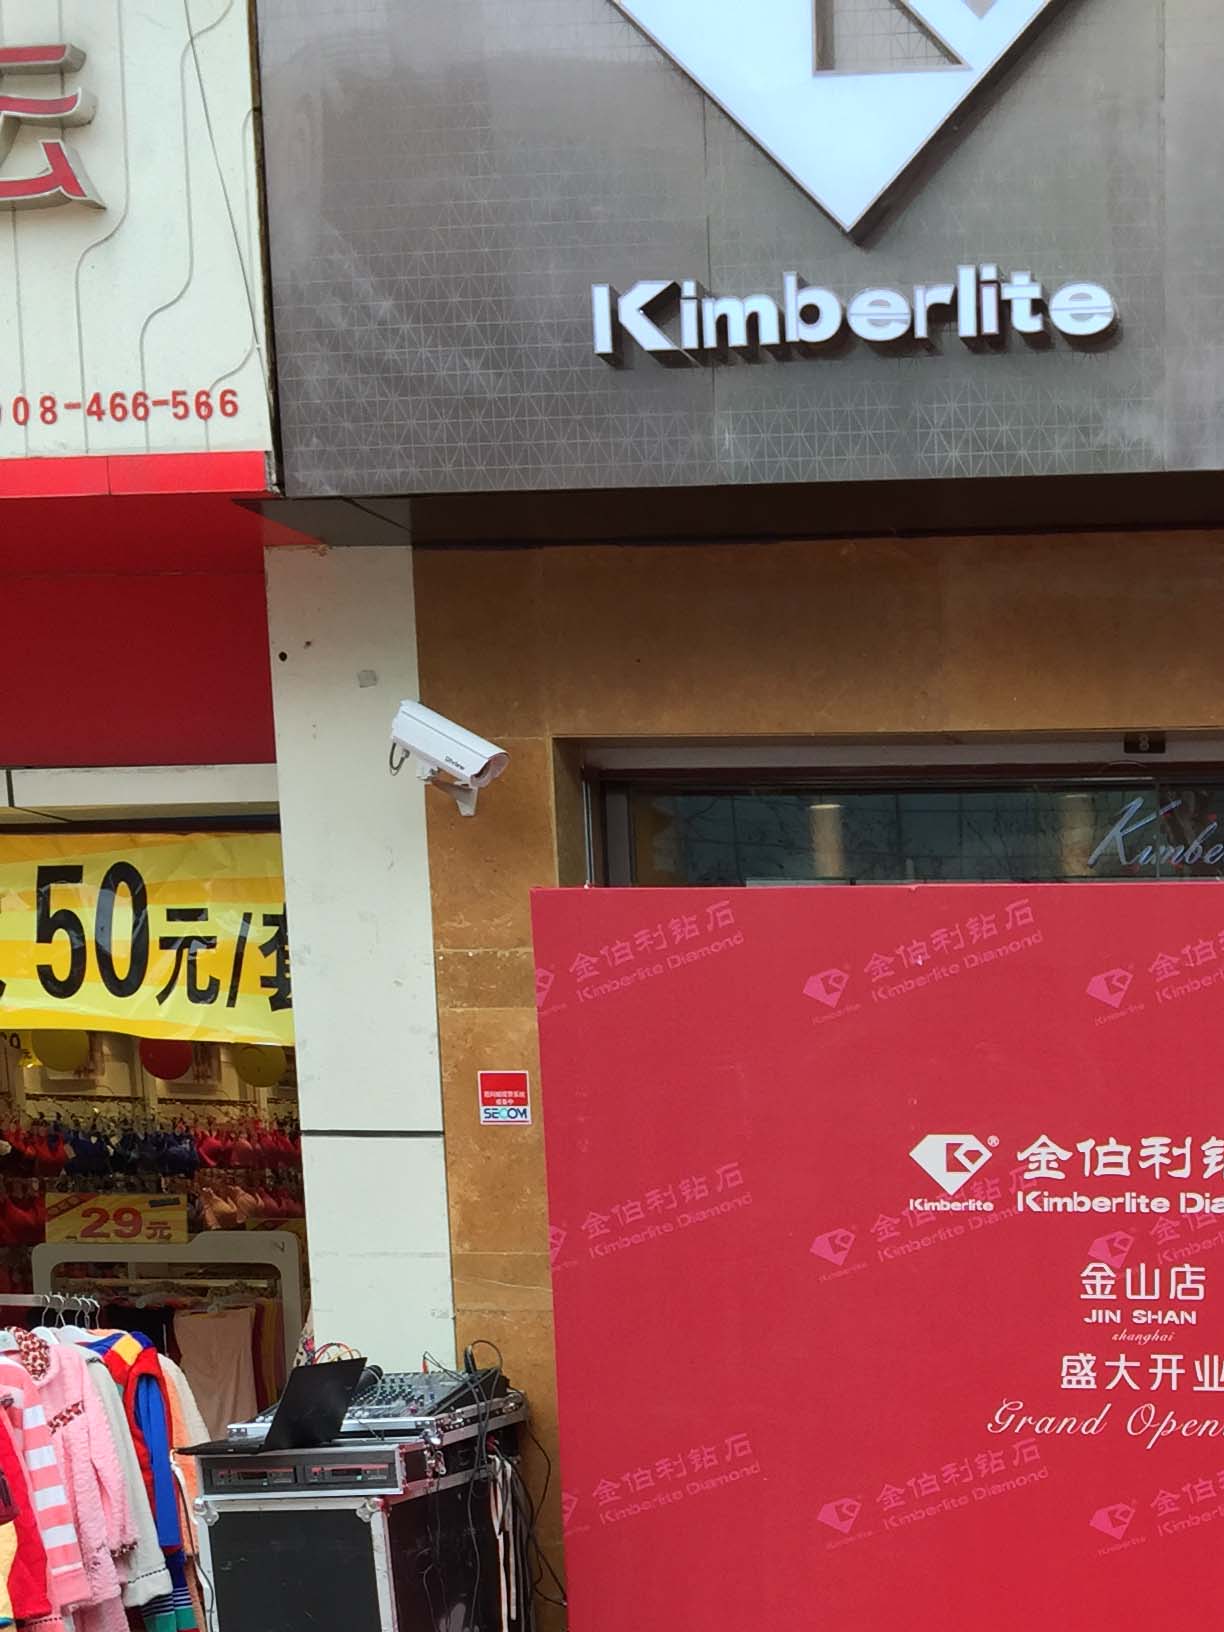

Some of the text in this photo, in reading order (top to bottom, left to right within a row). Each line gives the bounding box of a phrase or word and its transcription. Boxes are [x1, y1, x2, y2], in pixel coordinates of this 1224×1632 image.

[592, 264, 1115, 354] Kimberlite
[0, 388, 239, 426] 08-466-566
[483, 1108, 527, 1119] SECOM
[909, 1198, 994, 1212] Kimberlite
[1017, 1190, 1171, 1214] Kimberlite
[1080, 1262, 1206, 1301] 金山店
[1084, 1309, 1197, 1325] JIN SHAN
[1111, 1330, 1175, 1345] shanghai
[987, 1399, 1112, 1435] Grand
